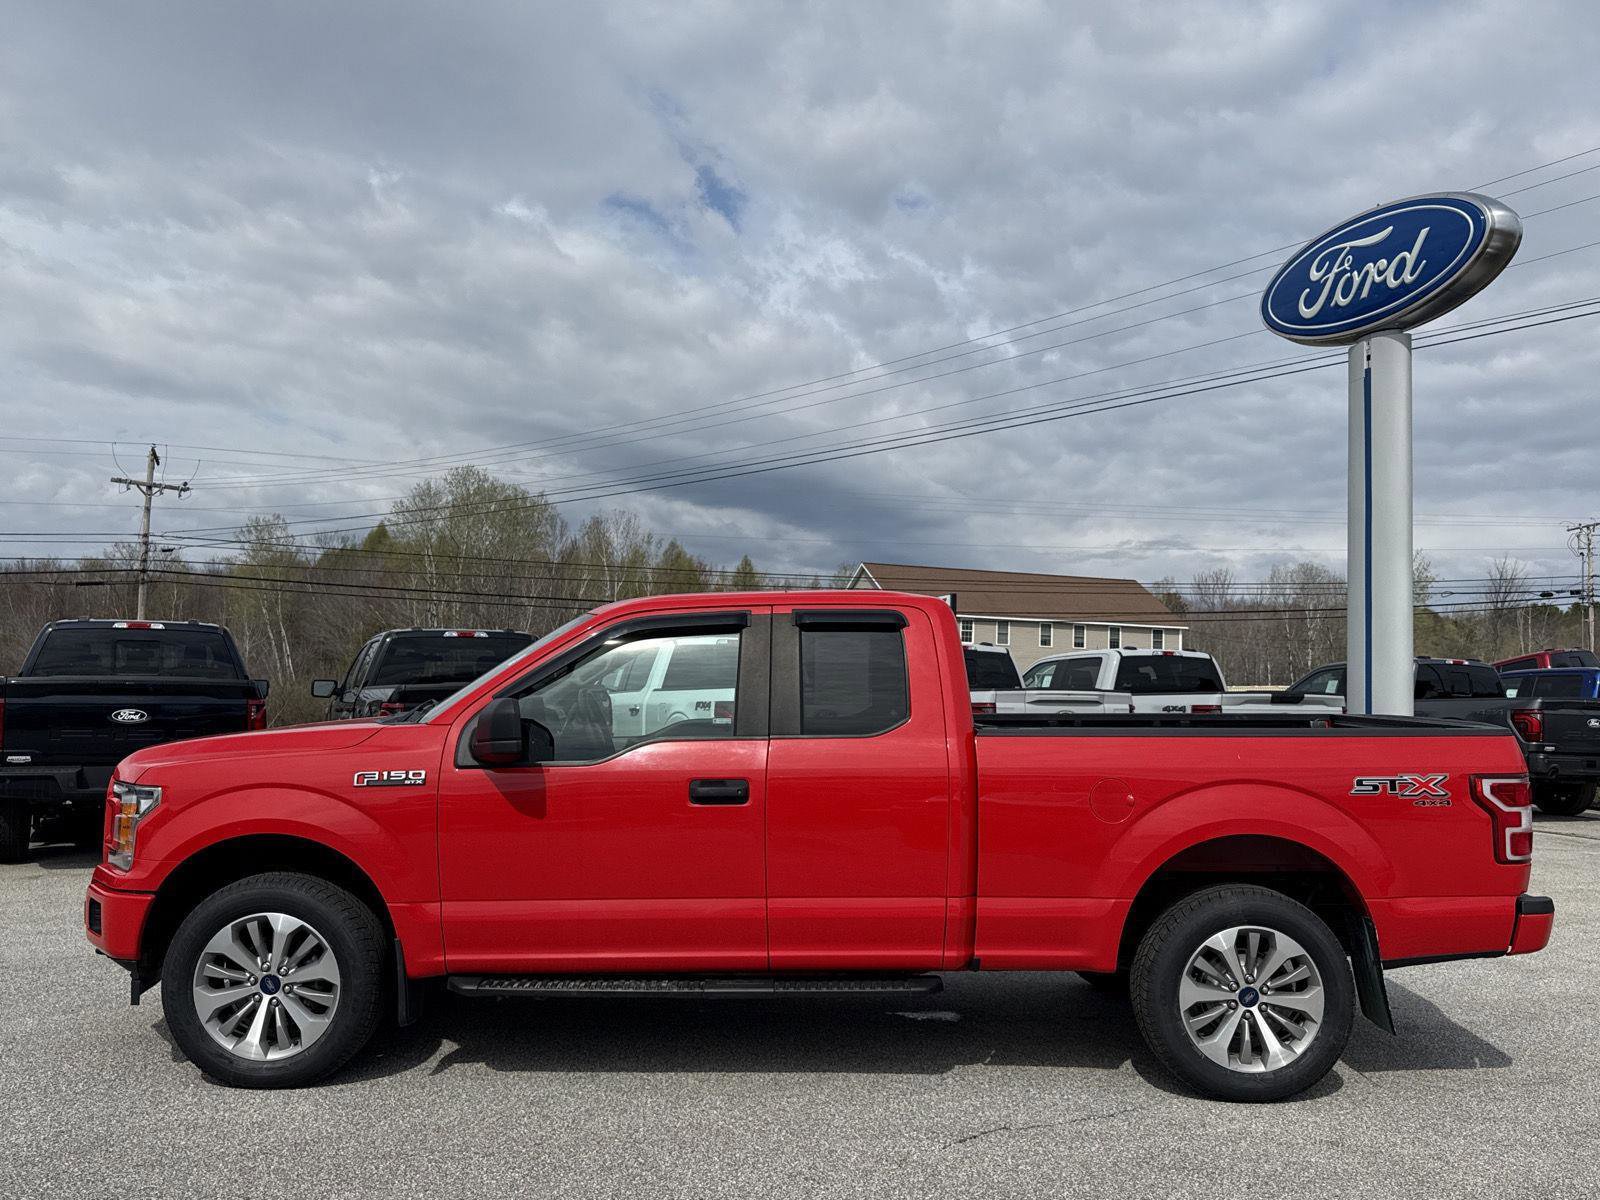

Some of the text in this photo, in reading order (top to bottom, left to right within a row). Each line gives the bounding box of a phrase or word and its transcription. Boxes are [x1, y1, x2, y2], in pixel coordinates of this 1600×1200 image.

[1298, 226, 1430, 319] Ford
[118, 711, 141, 720] Ford
[1349, 774, 1451, 798] STX
